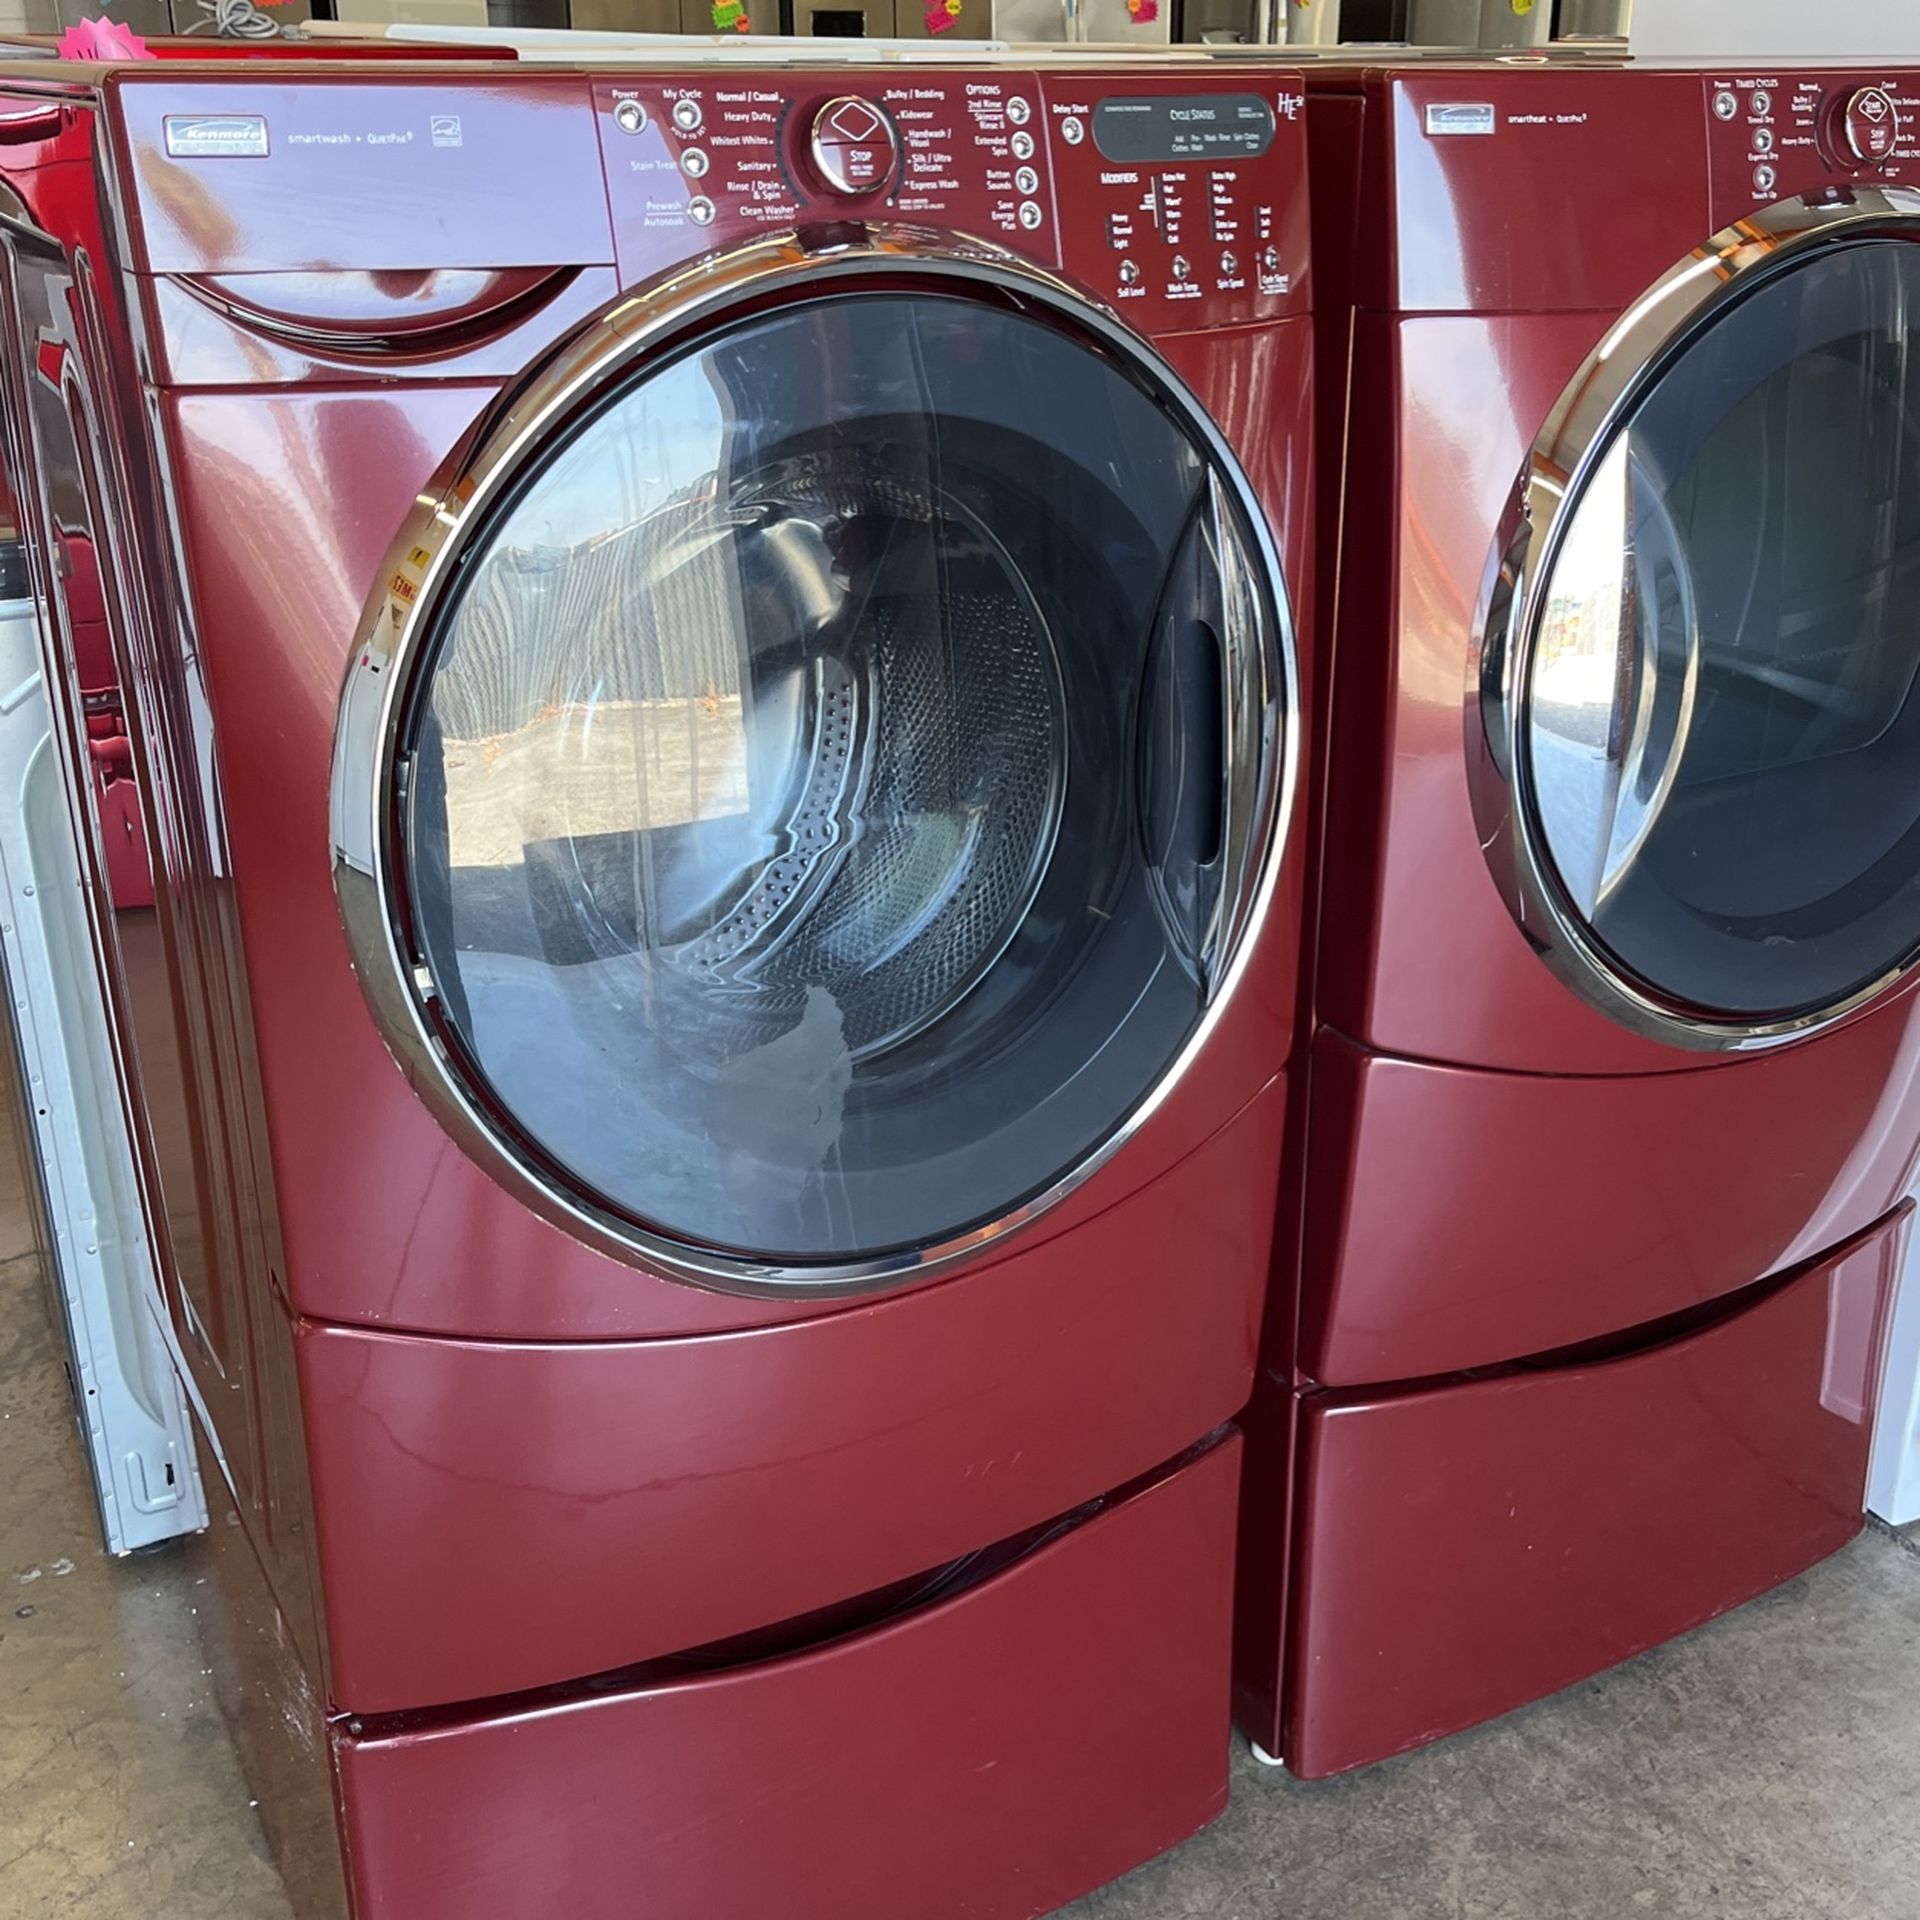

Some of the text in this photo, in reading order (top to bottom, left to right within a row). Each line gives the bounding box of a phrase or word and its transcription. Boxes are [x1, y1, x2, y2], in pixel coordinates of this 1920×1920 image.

[612, 89, 639, 99] Power
[662, 88, 702, 100] My Cycle
[716, 91, 746, 101] Normal
[753, 91, 779, 102] Casual
[886, 89, 908, 100] Bulky
[914, 89, 944, 100] Bedding
[968, 99, 1002, 109] 2nd Rinse
[1052, 103, 1089, 115] Delay Start
[724, 111, 771, 123] Heavy Duty
[900, 110, 934, 119] Kidswear
[1508, 114, 1547, 123] smartheat
[979, 121, 999, 130] Rinse
[186, 129, 260, 140] Kenmore
[288, 133, 350, 144] smartwash
[908, 129, 946, 138] Handwash
[710, 135, 768, 146] Whitest Whites
[910, 139, 930, 148] Wool
[974, 135, 1007, 145] Extended
[850, 150, 872, 162] STOP
[992, 146, 1008, 157] Spin
[912, 153, 926, 163] Silk
[933, 153, 952, 163] Ultra
[630, 160, 654, 171] Stain
[737, 161, 771, 172] Sanitary
[913, 163, 944, 173] Delicate
[986, 169, 1011, 179] Button
[727, 181, 749, 191] Rinse
[757, 180, 779, 191] Drain
[910, 179, 959, 191] Express Wash
[986, 180, 1012, 191] Sounds
[753, 190, 781, 201] & Spin
[646, 200, 682, 210] Prewash
[997, 199, 1014, 210] Save
[740, 205, 795, 216] Clean Washer
[644, 217, 684, 227] Autosoak
[991, 211, 1015, 222] Energy
[1001, 221, 1017, 231] Plus
[1167, 281, 1199, 292] Wash Temp
[1216, 278, 1245, 290] Spin Speed
[1117, 285, 1146, 297] Soil Level
